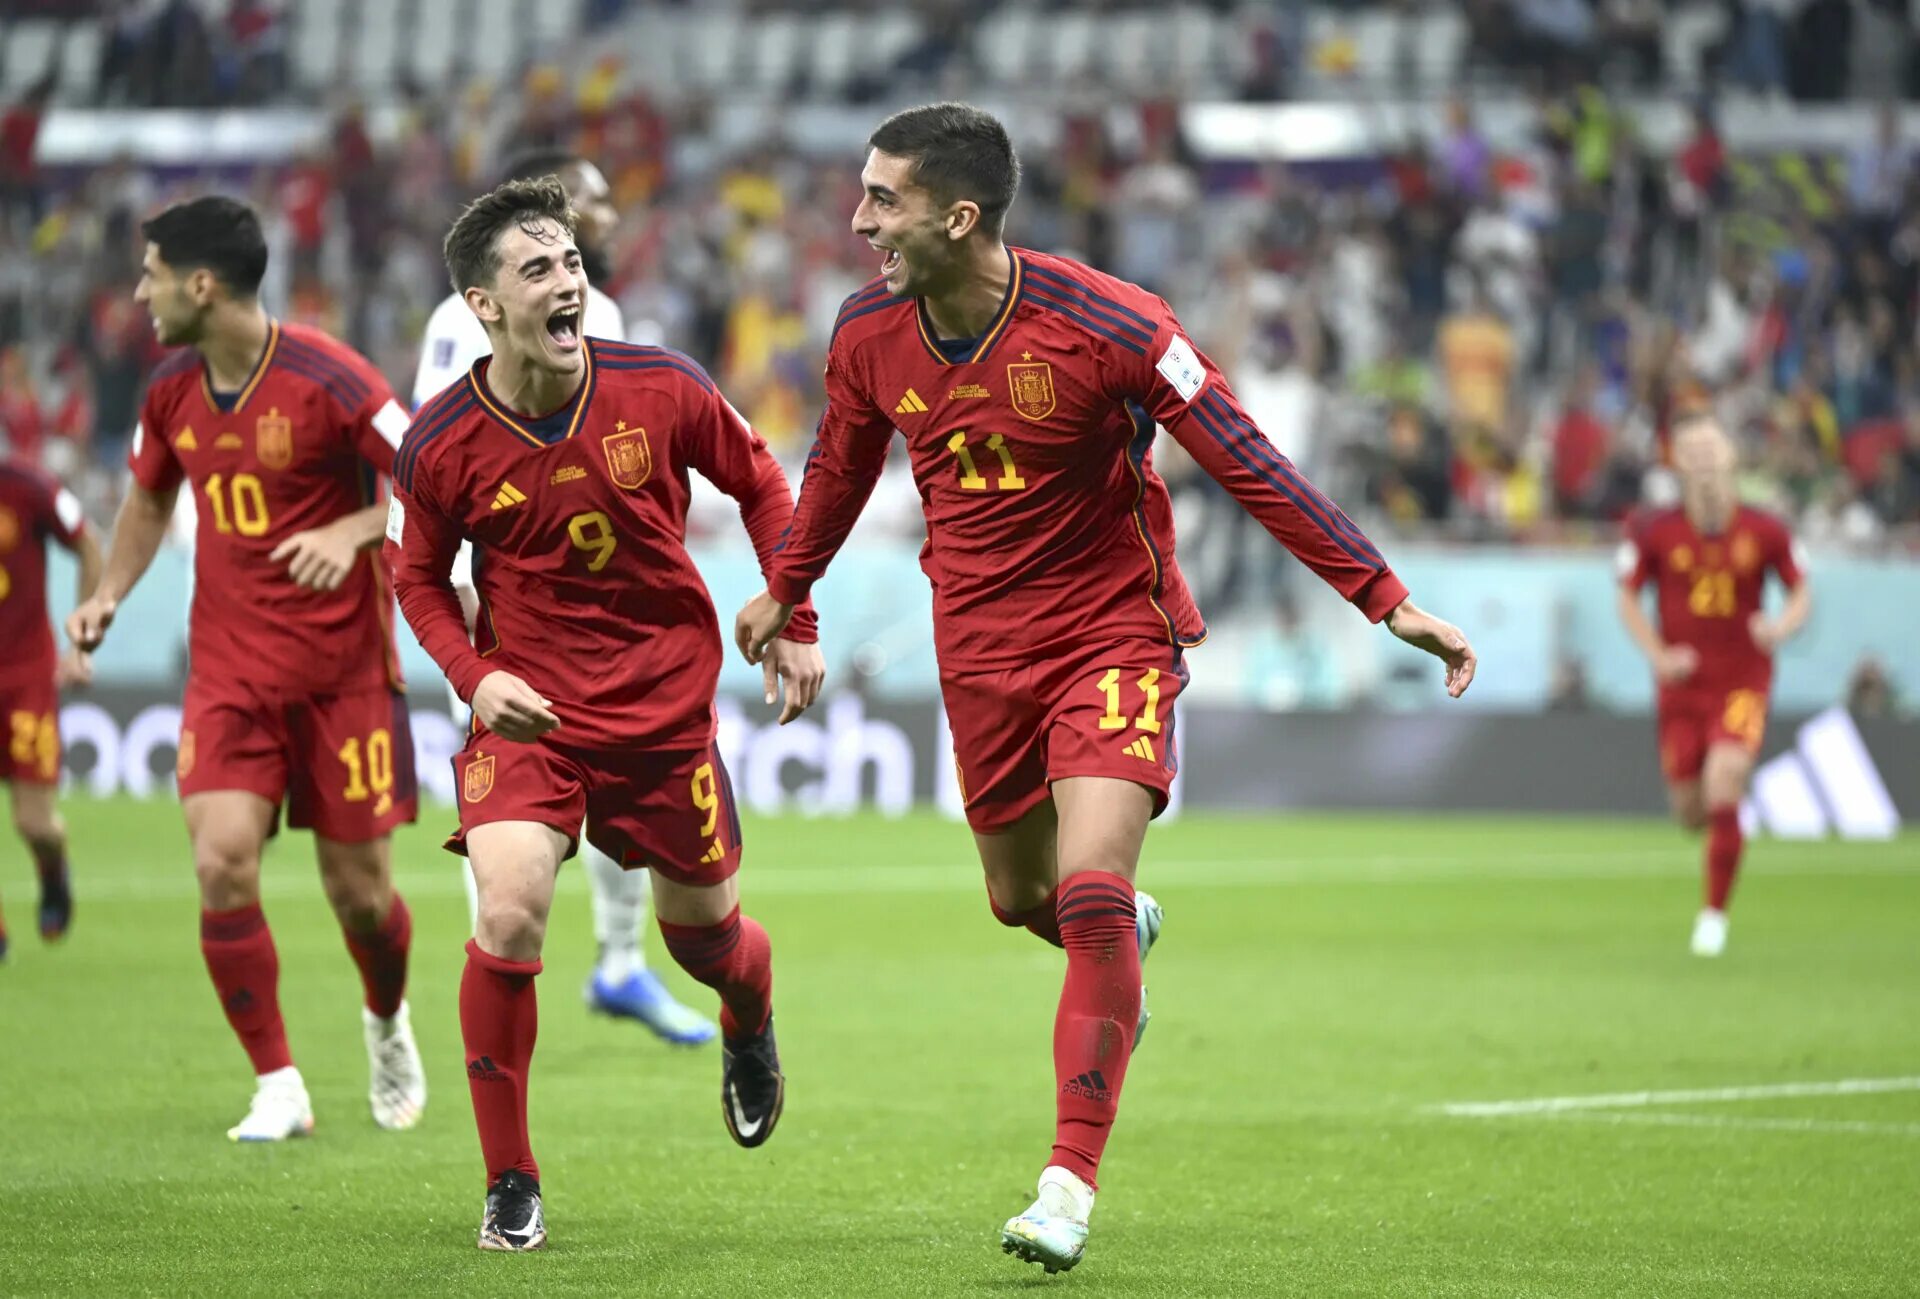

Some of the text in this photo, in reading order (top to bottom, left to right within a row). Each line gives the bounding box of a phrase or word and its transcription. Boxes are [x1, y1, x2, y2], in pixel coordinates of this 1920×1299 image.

[947, 431, 1026, 490] 11
[204, 472, 269, 536] 10
[568, 511, 617, 572] 9
[1096, 667, 1162, 734] 11
[338, 727, 393, 802] 10
[691, 762, 718, 837] 9
[1063, 1083, 1113, 1103] adidas
